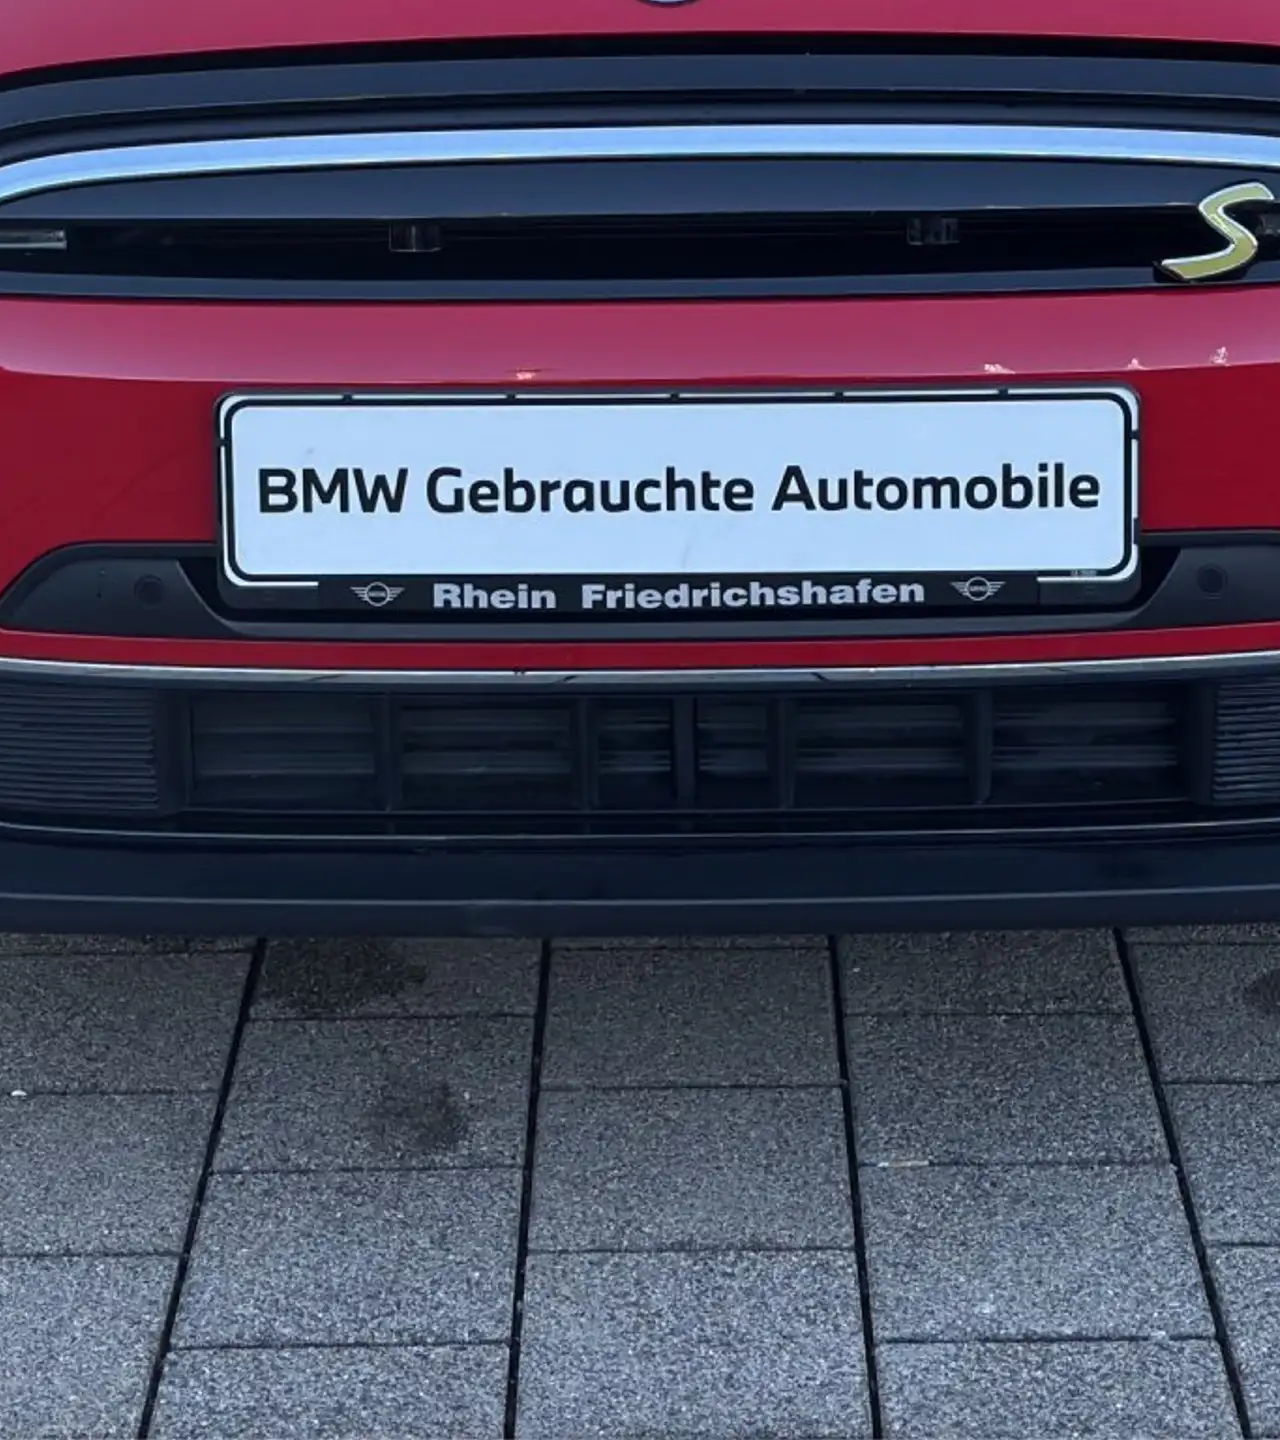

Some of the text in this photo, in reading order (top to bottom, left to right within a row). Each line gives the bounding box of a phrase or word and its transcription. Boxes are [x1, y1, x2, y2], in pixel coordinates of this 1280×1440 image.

[1160, 181, 1275, 279] S
[258, 462, 1101, 514] BMW Gebrauchte Automobile
[432, 578, 925, 609] Rhein Friedrichshafen
